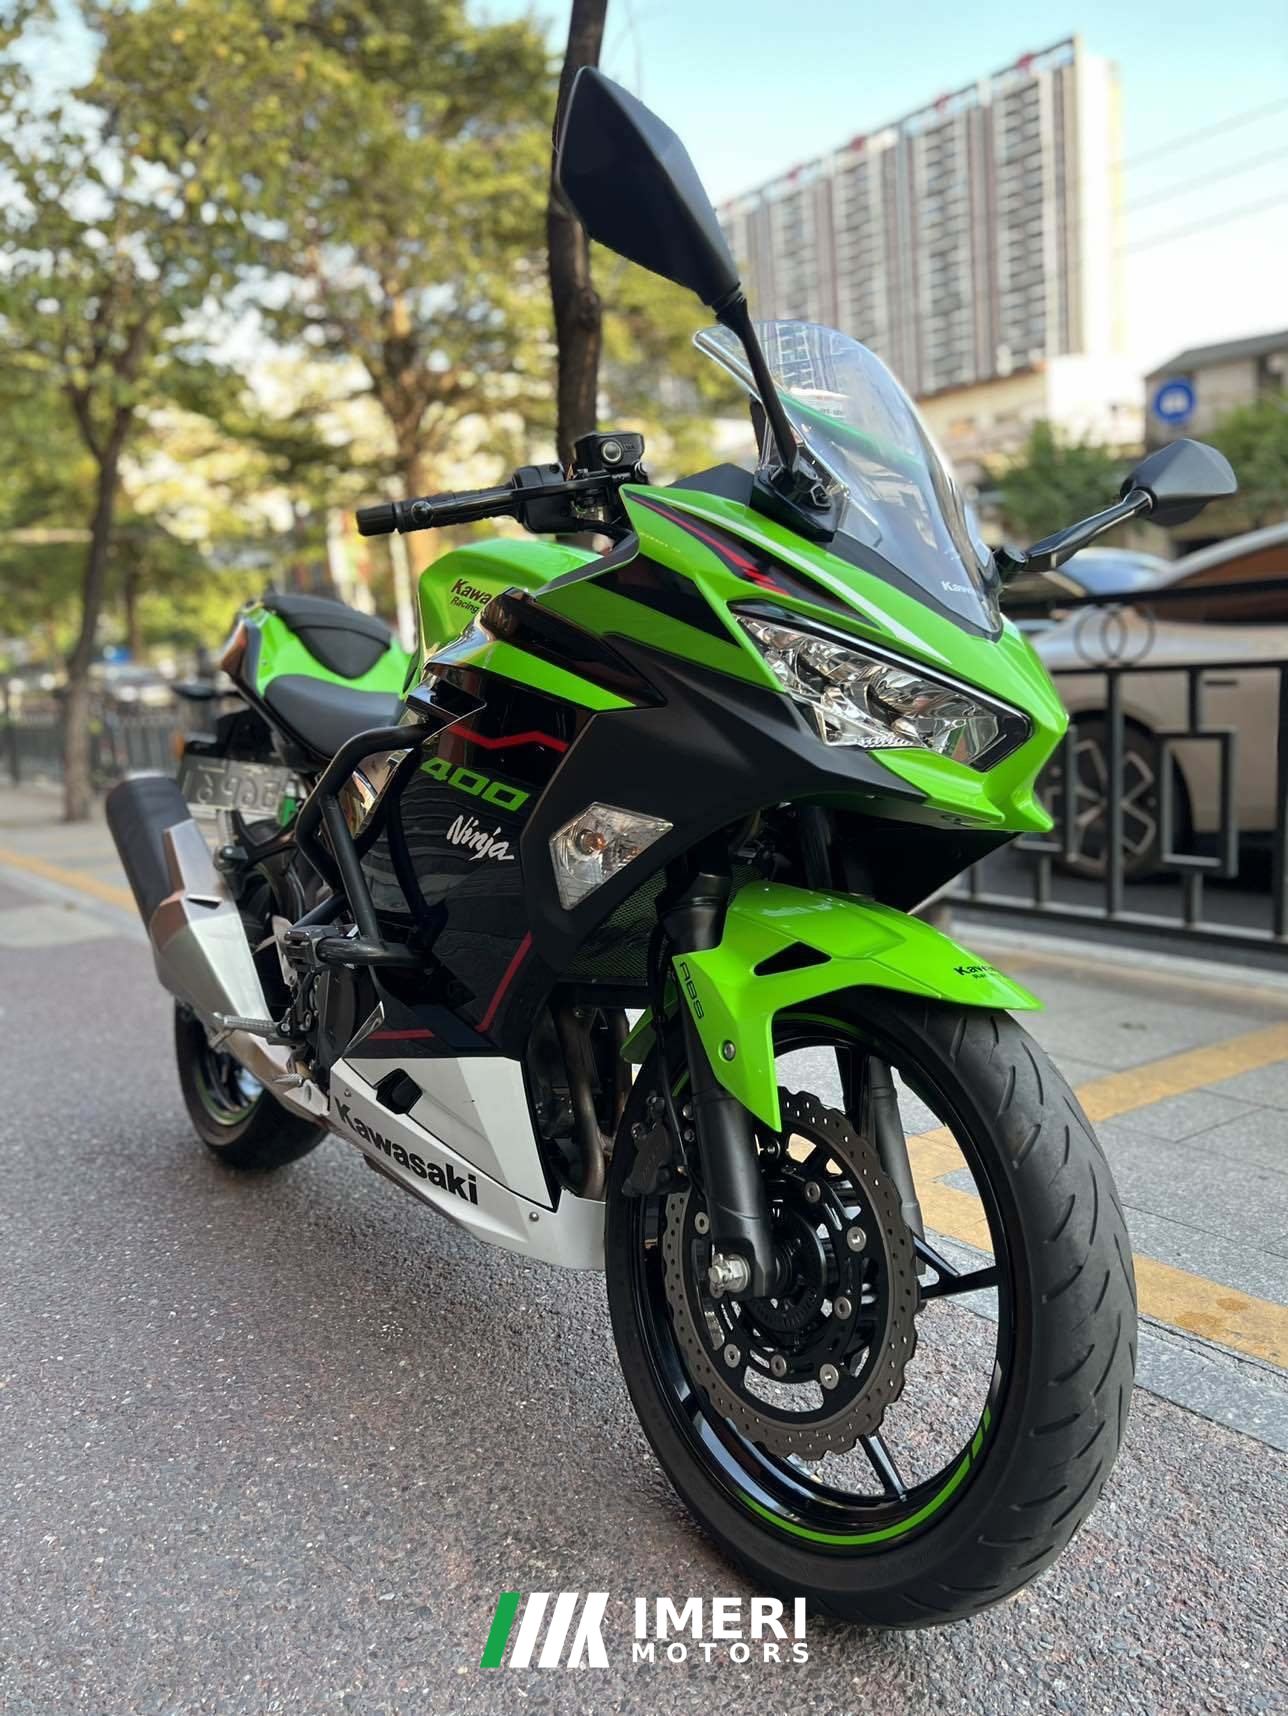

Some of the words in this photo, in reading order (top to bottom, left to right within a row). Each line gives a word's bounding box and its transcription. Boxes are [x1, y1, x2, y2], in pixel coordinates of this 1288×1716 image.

[420, 757, 530, 811] 400
[446, 815, 515, 860] Ninja
[680, 961, 705, 1019] ABS
[335, 1096, 478, 1205] Kawasaki
